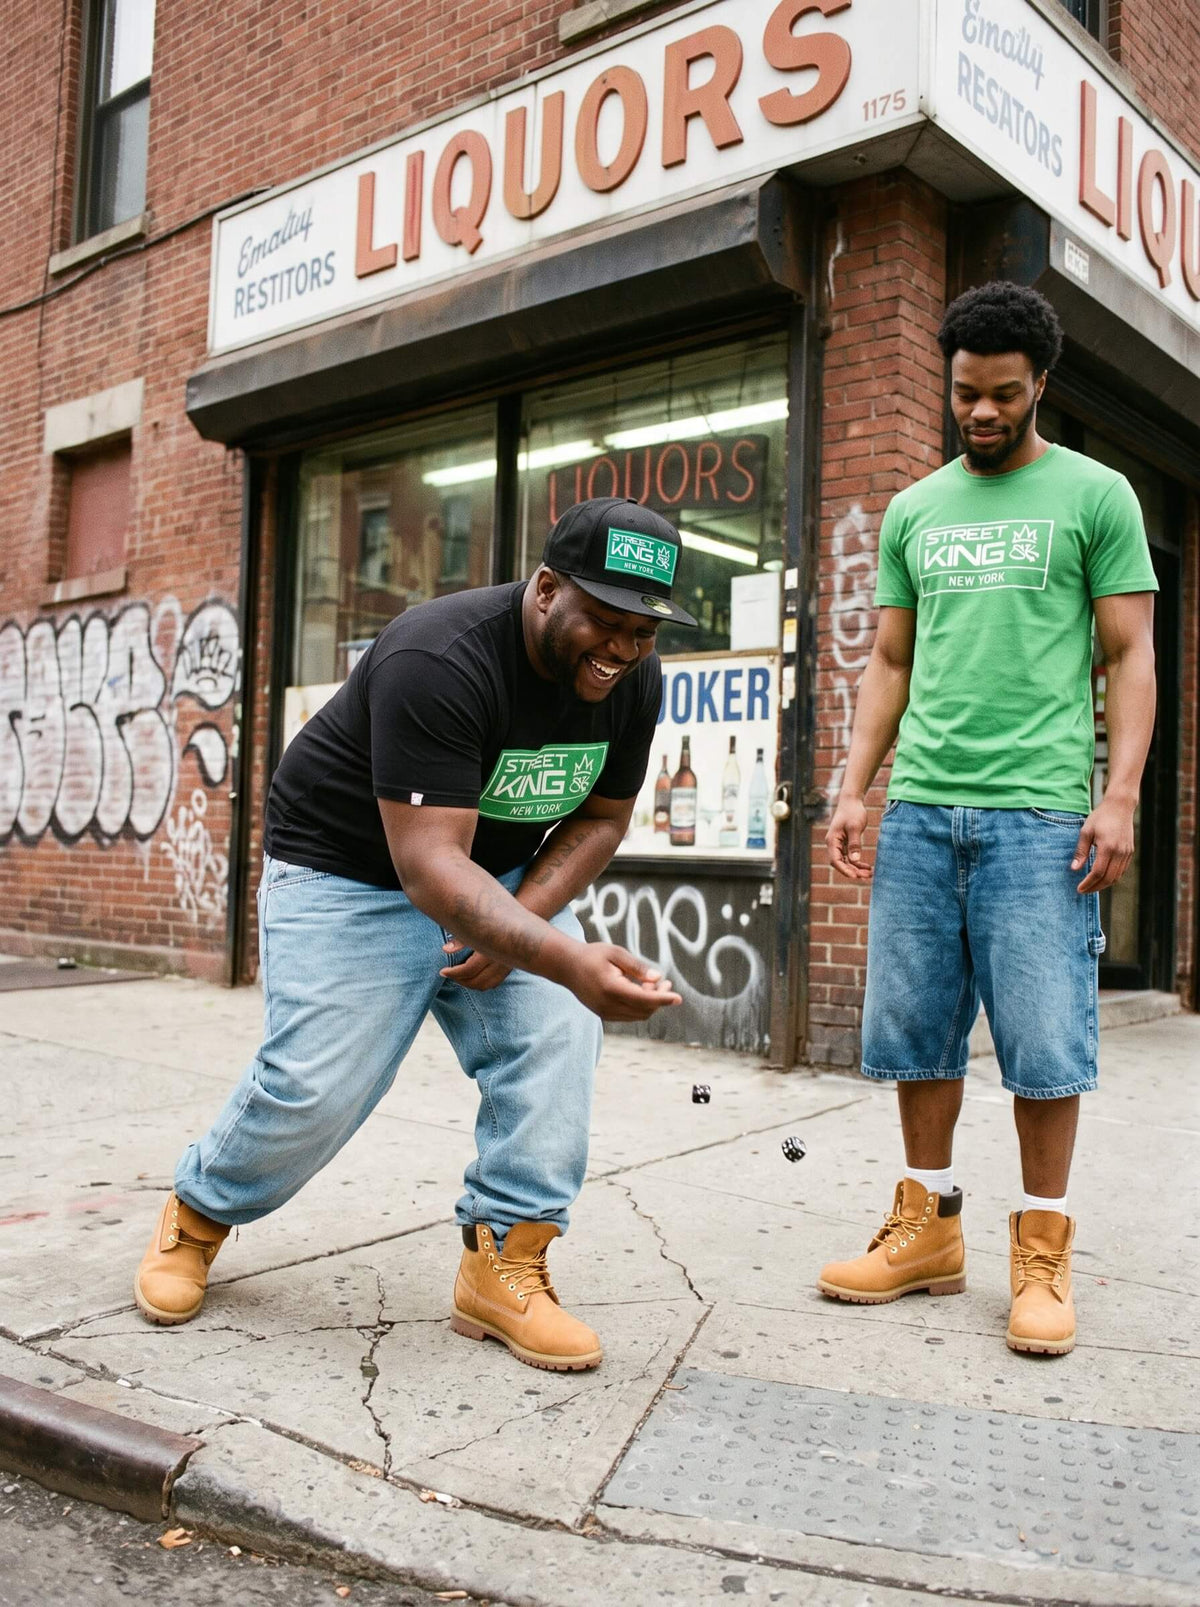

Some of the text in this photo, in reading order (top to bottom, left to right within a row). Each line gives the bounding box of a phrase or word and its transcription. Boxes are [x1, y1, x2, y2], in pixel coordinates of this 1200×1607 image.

[862, 88, 906, 122] 1175
[957, 50, 1063, 178] RESATORS
[355, 0, 852, 280] LIQUORS
[234, 250, 335, 319] RESTITORS
[612, 533, 655, 549] STREET
[925, 525, 1008, 546] STREET
[611, 541, 654, 563] KING
[924, 541, 1006, 570] KING
[623, 562, 654, 576] NEW YORK
[948, 571, 1005, 587] NEW YORK
[504, 753, 568, 772] STREET
[492, 770, 566, 798] KING
[509, 803, 563, 816] NEW YORK
